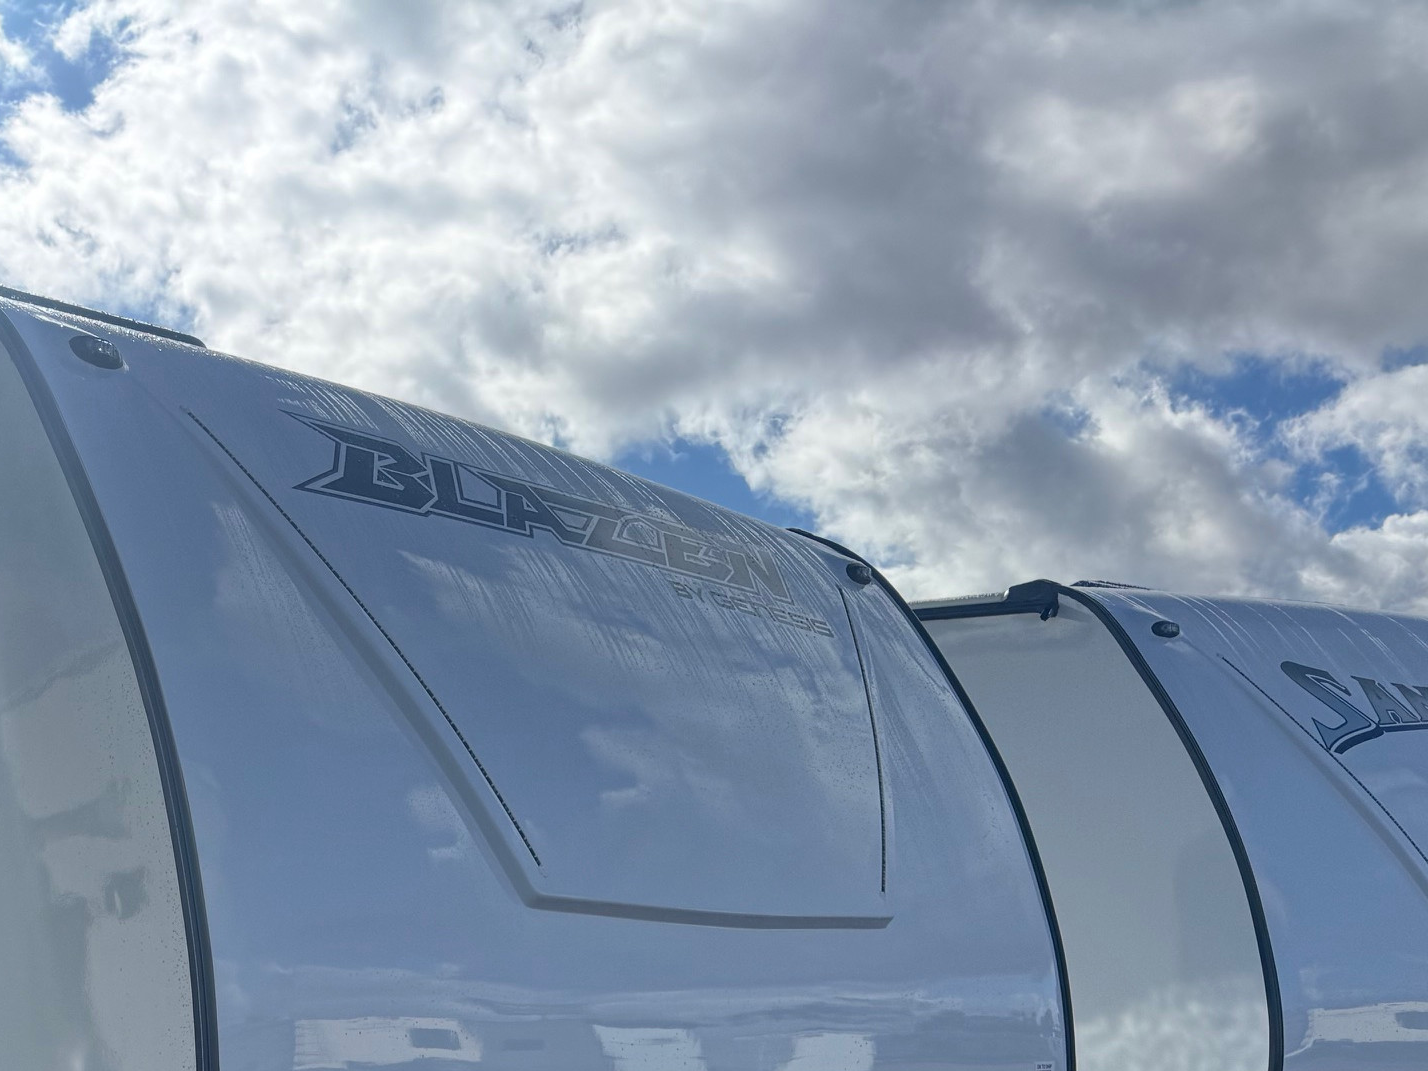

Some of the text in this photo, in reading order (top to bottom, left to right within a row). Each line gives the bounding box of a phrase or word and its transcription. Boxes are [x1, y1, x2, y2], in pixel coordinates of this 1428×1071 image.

[278, 408, 794, 606] BLAZEN
[667, 579, 834, 638] BY GENESIS
